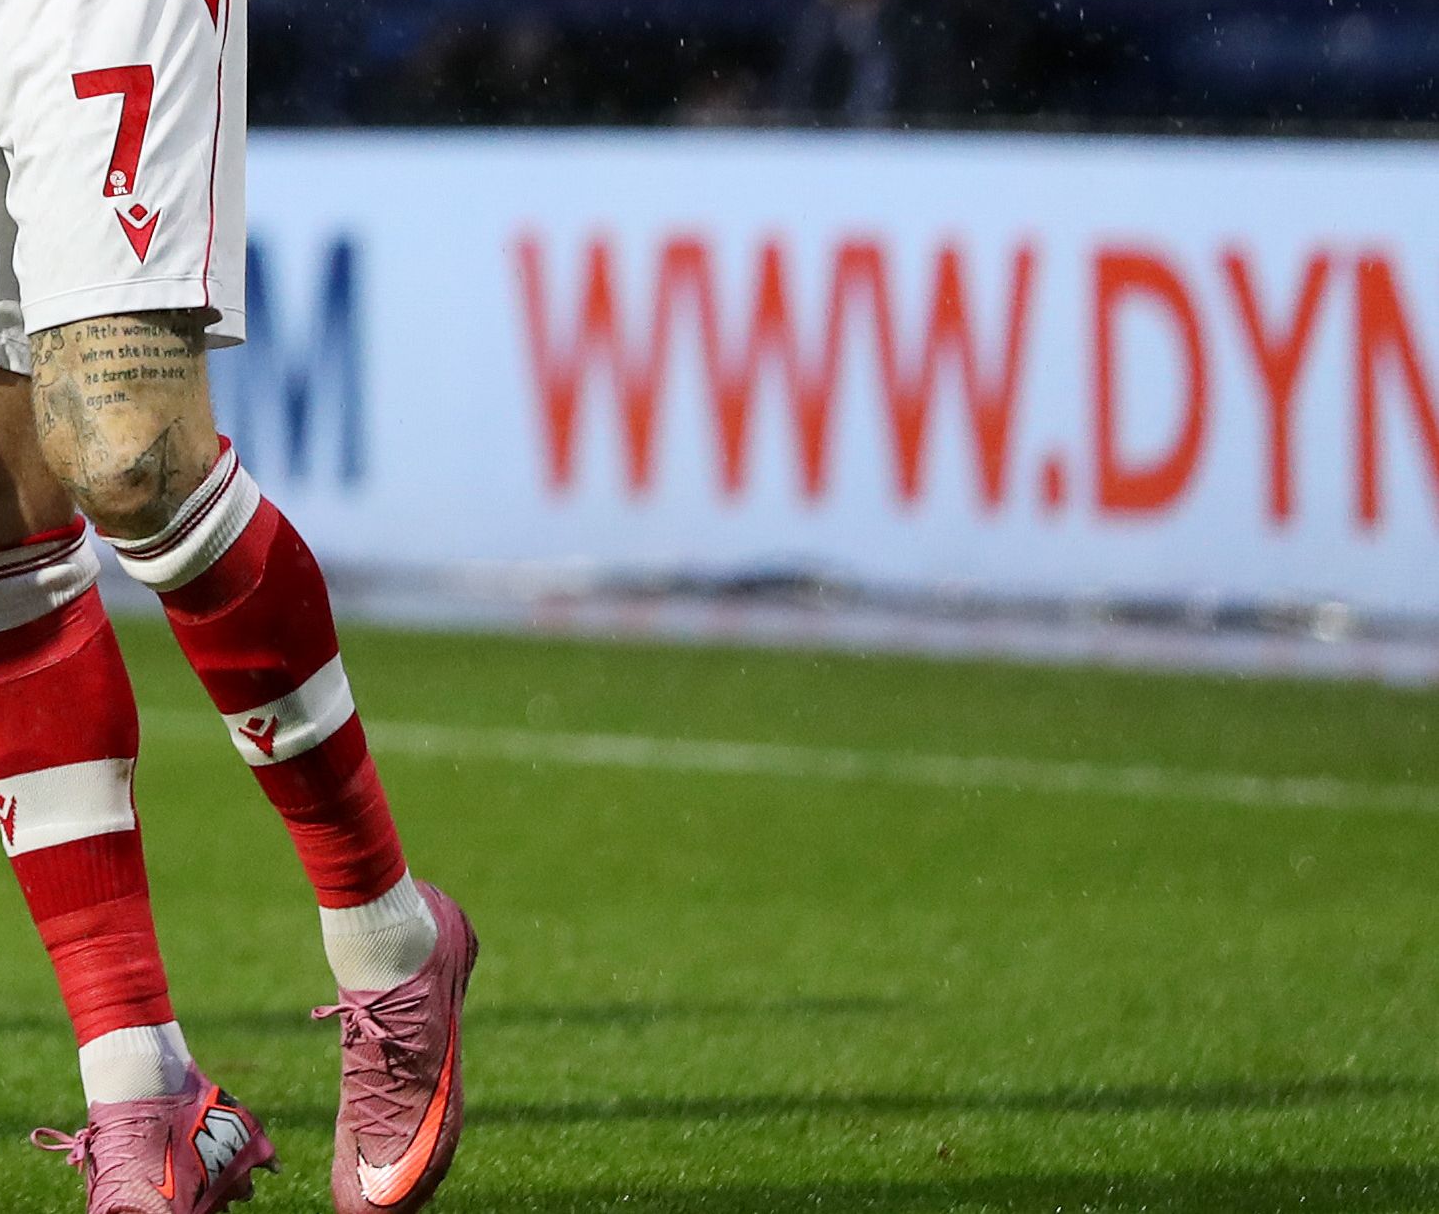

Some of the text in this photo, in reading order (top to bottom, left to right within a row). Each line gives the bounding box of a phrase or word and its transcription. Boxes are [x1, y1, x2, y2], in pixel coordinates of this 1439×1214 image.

[72, 64, 154, 197] 7
[118, 344, 140, 358] she
[511, 226, 1439, 528] WWW.DYN
